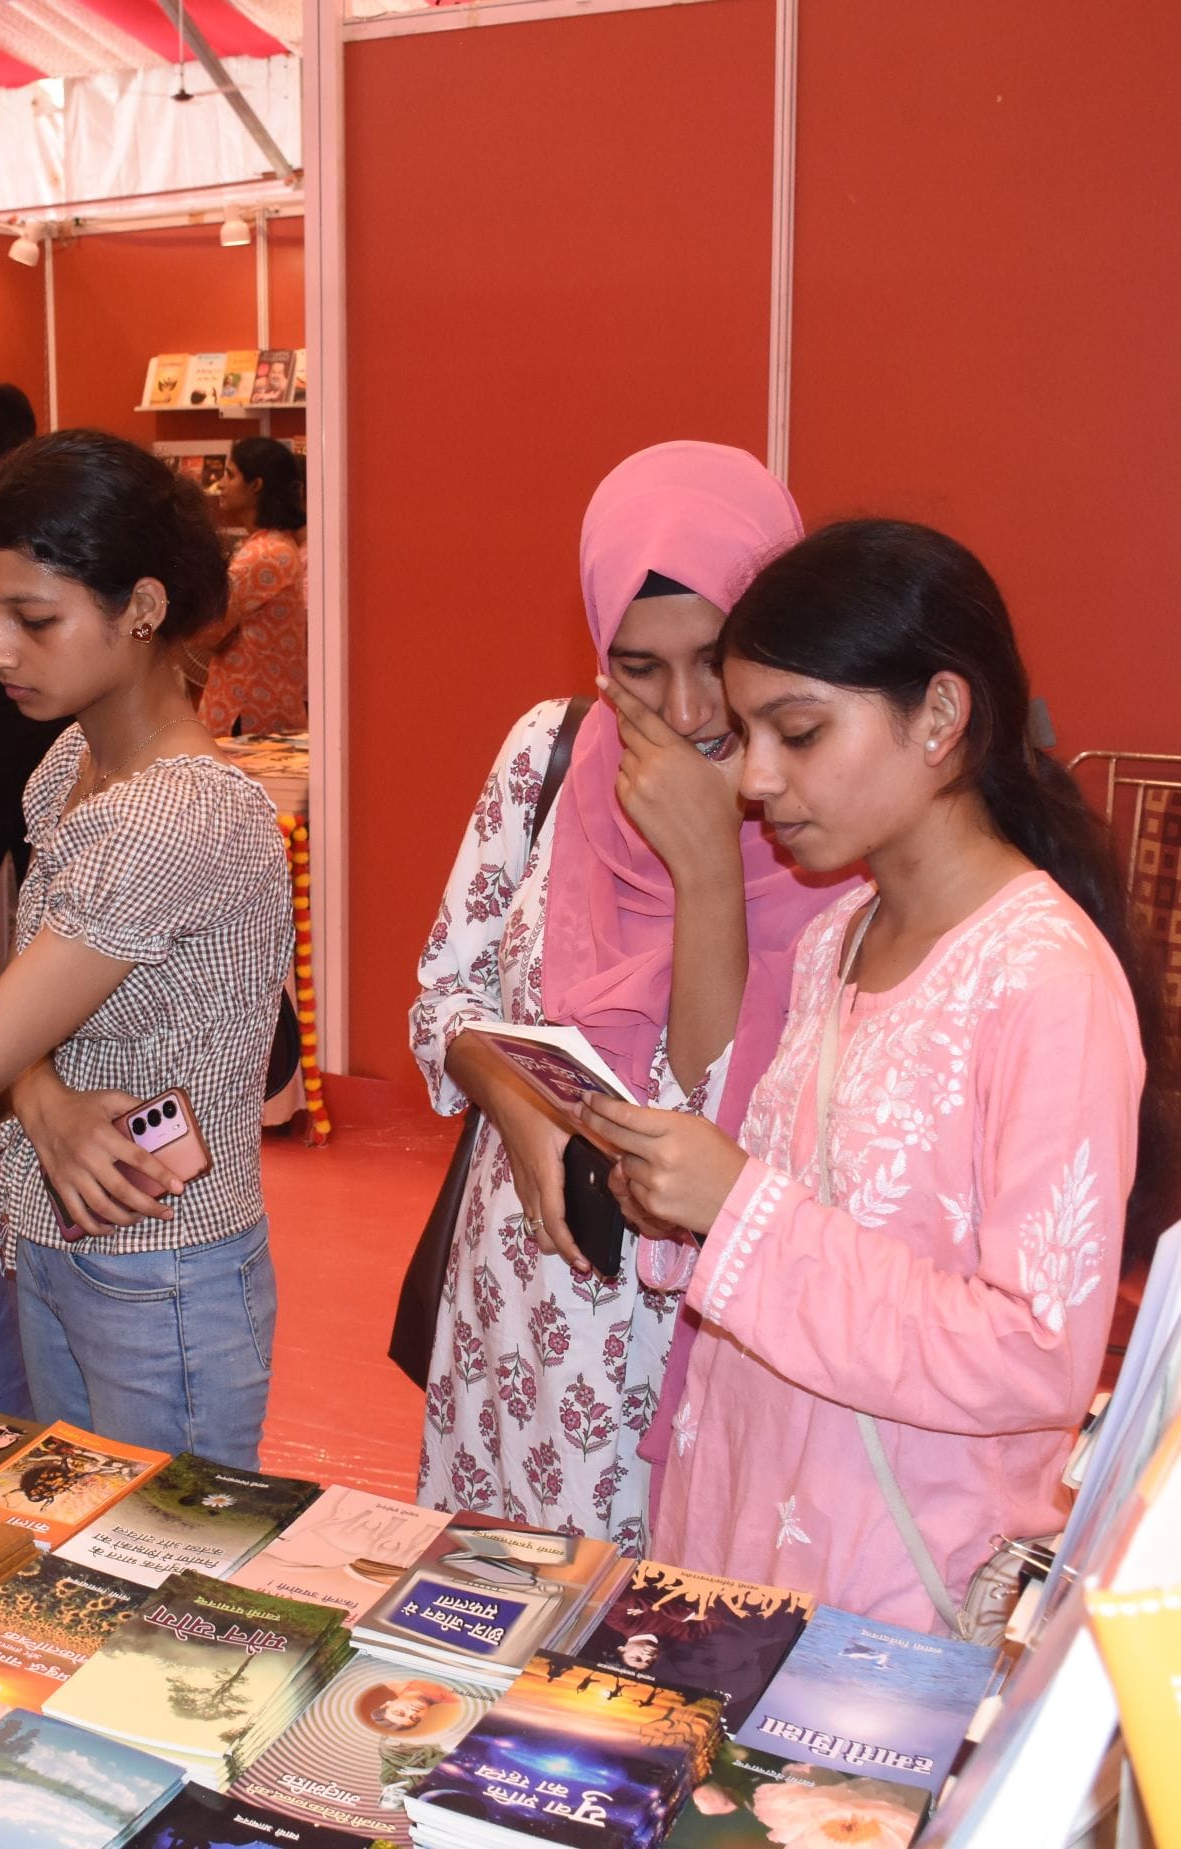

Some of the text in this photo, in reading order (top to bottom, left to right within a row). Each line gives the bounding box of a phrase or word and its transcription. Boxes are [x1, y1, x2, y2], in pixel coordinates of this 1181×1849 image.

[91, 1533, 220, 1569] निर्माण में शिक्षकों का
[112, 1525, 224, 1558] कर्तव्य और दायित्व
[87, 1544, 197, 1575] धुनिक भारत के
[193, 1594, 281, 1622] स्वामी परमानन्द
[275, 1581, 323, 1601] उपयोगी
[324, 1593, 358, 1610] कितनी
[432, 1594, 500, 1621] सफलता
[145, 1605, 287, 1656] मौन योग
[400, 1602, 505, 1647] छात्र-जीवन में
[24, 1660, 73, 1681] प्रबुद्ध
[758, 1713, 935, 1776] हमारी शिक्षा
[278, 1772, 362, 1807] मातृभक्ति
[472, 1764, 570, 1800] का रहस्य
[244, 1783, 398, 1833] स्वामी विवेकानन्द की
[482, 1784, 614, 1829] युवा शक्ति
[274, 1822, 301, 1841] स्वामी
